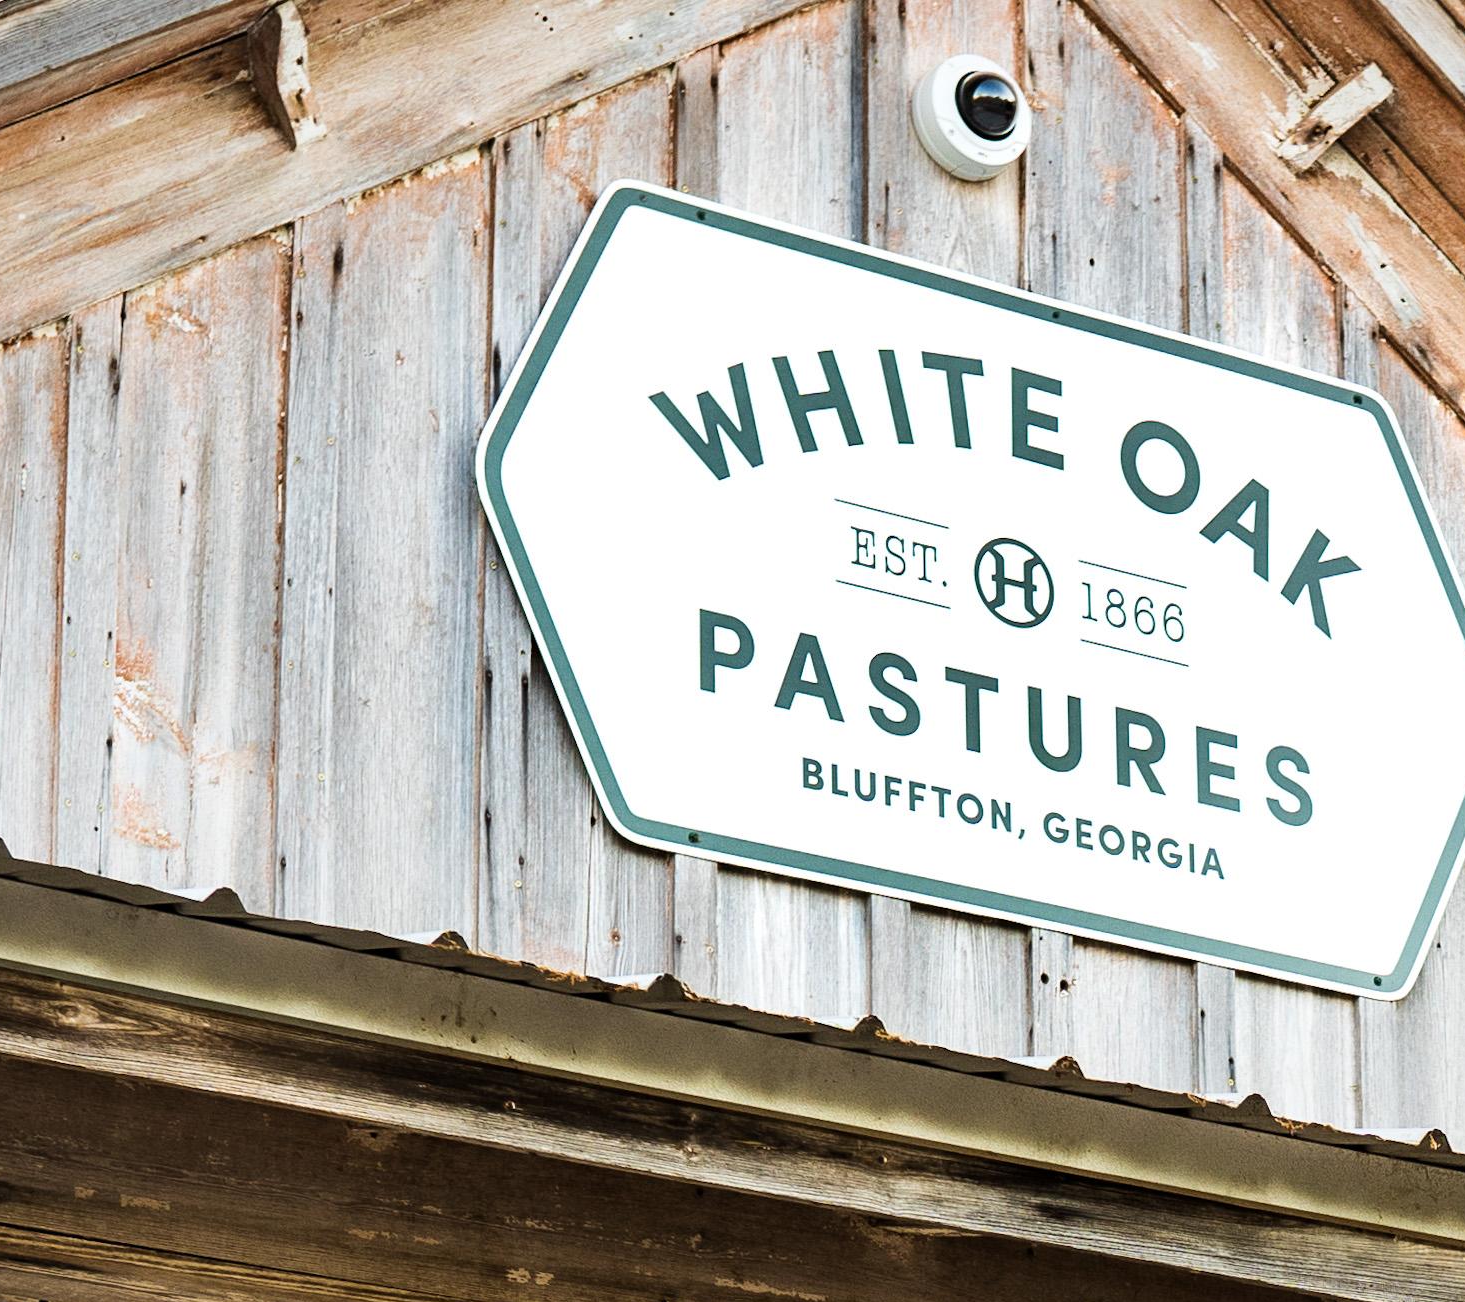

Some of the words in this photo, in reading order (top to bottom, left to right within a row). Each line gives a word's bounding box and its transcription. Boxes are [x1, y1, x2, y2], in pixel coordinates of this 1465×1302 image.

[647, 348, 1065, 481] WHITE
[1120, 419, 1363, 640] OAK
[849, 525, 948, 588] EST.
[1080, 581, 1185, 643] 1866
[698, 608, 1313, 827] PASTURES
[802, 757, 1027, 841] BLUFFTON,
[1043, 811, 1225, 880] GEORGIA
